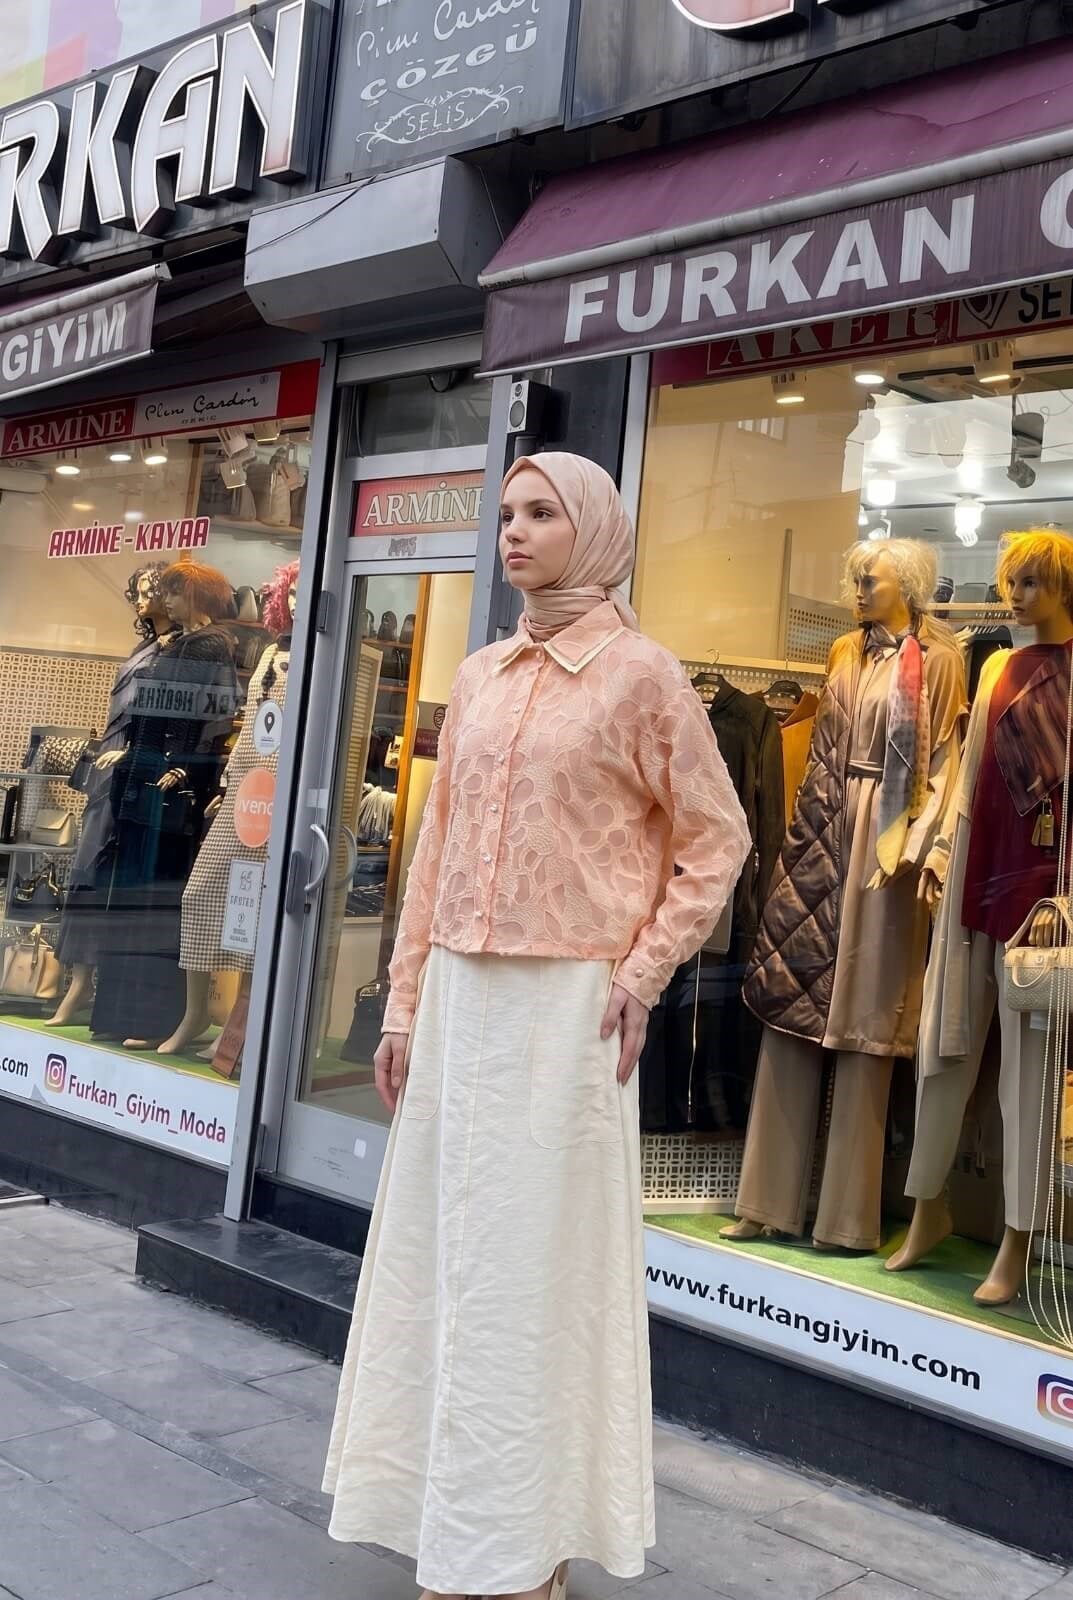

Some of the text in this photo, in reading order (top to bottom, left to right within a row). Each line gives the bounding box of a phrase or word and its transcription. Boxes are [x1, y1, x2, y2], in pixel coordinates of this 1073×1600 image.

[360, 20, 538, 108] ÇÖZGÜ
[563, 194, 975, 345] FURKAN
[1018, 278, 1073, 324] SE
[7, 409, 128, 452] ARMİNE
[68, 1074, 227, 1143] Furkan_Giyim_Moda
